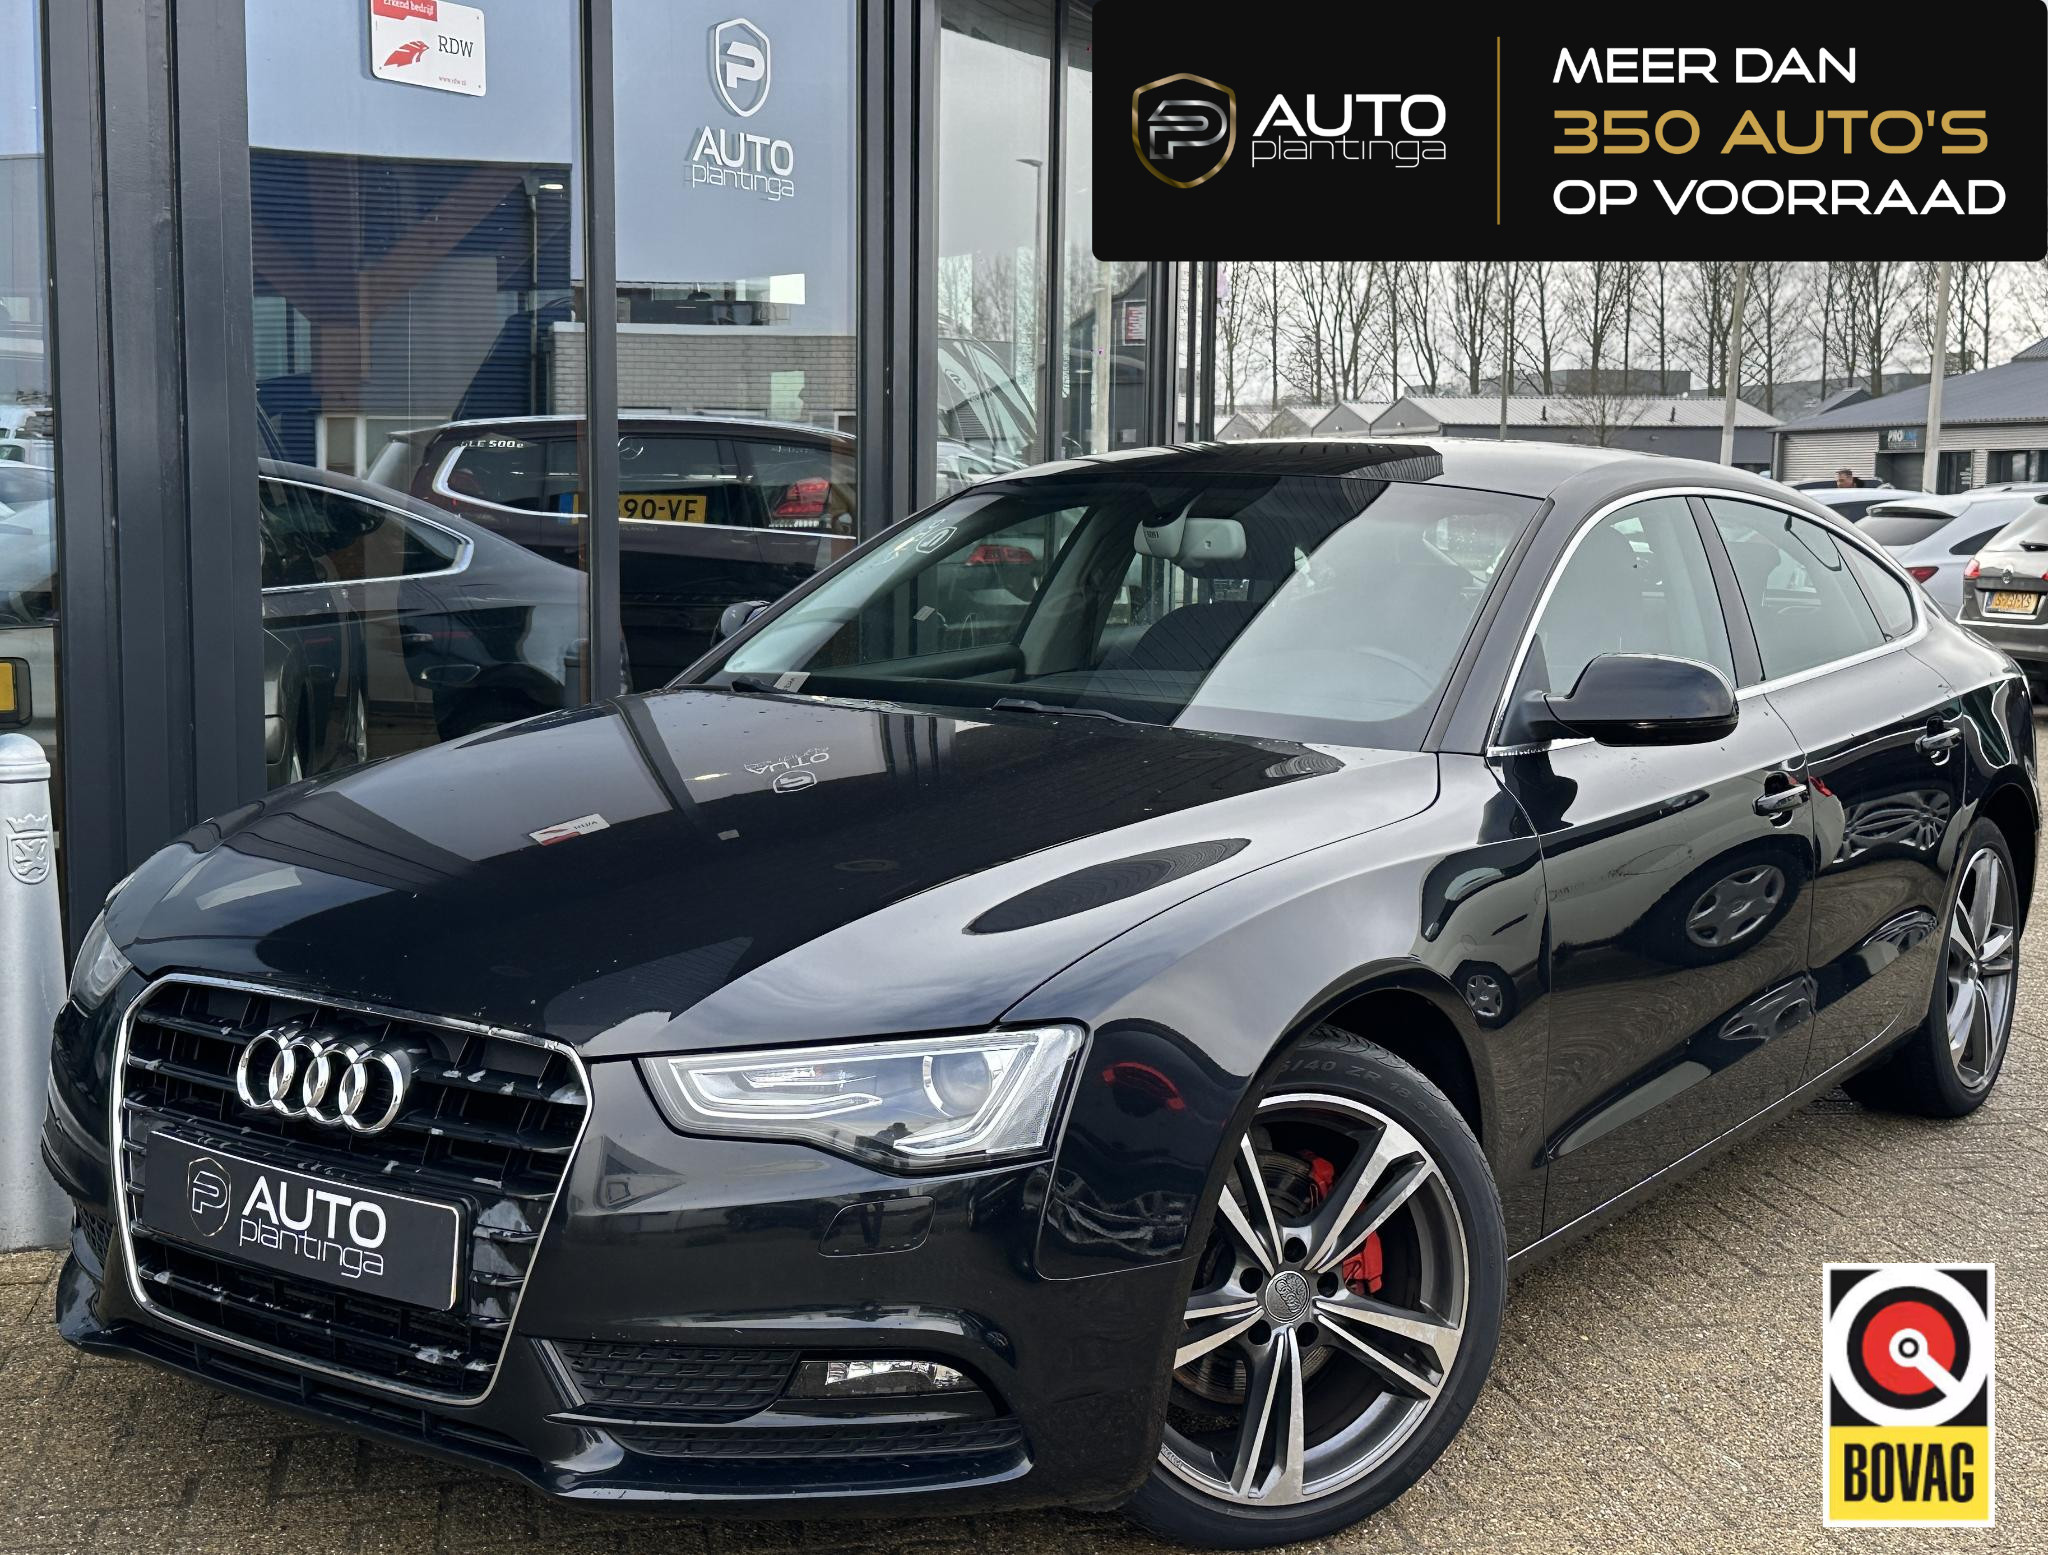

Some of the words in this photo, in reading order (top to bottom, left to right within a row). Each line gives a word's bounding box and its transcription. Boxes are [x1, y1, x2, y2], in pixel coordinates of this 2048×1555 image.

[438, 35, 474, 58] RDW
[692, 126, 794, 176] AUTO
[692, 161, 795, 201] plantinga
[242, 1175, 387, 1249] AUTO
[239, 1219, 385, 1278] plantinga
